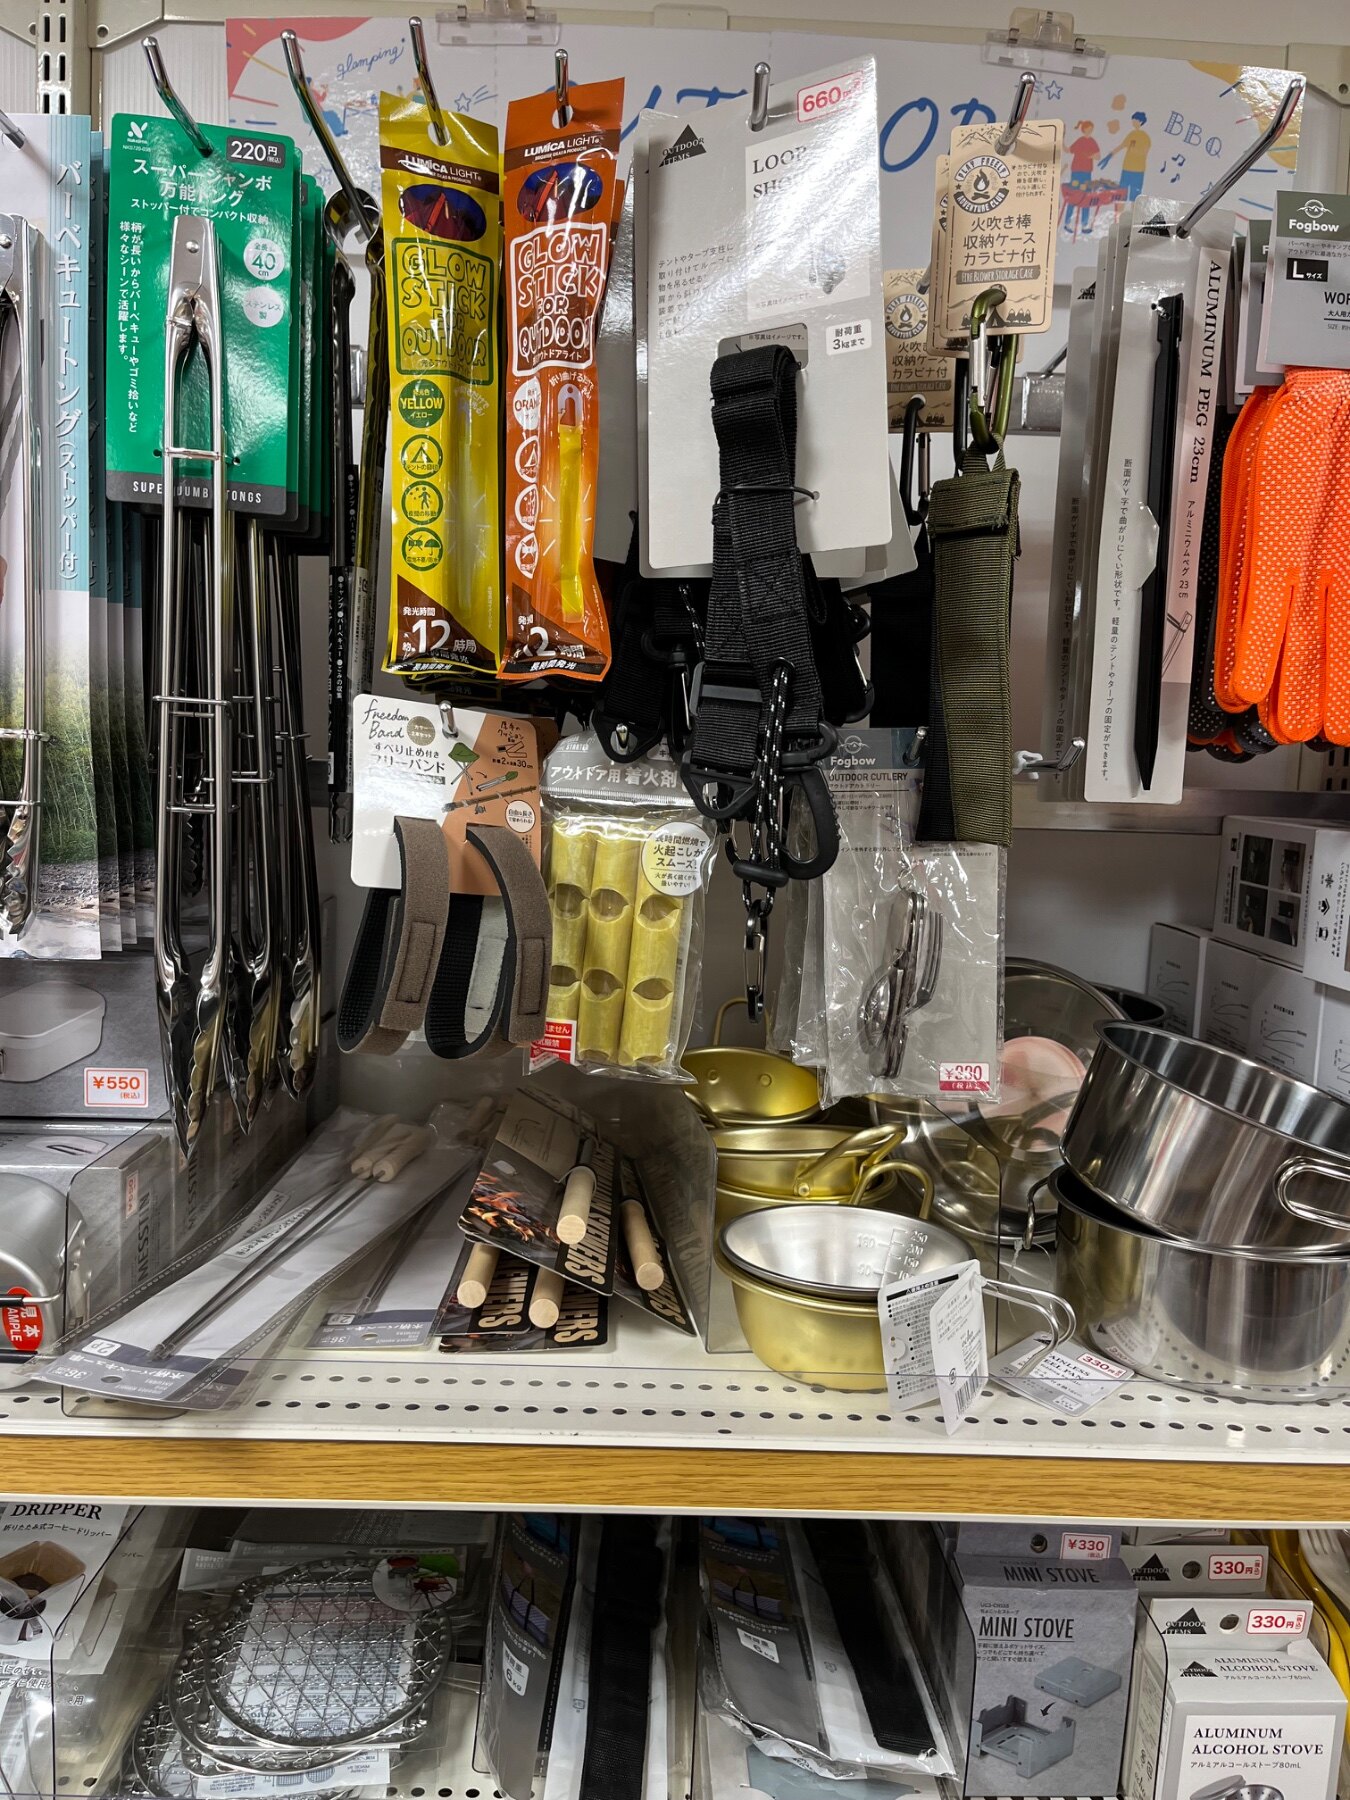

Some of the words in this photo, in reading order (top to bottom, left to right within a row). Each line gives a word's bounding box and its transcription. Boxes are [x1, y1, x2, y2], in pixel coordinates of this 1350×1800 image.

[337, 38, 406, 80] glamping
[1164, 110, 1222, 159] BBQ
[230, 140, 279, 162] 220円
[662, 136, 705, 156] OUTDOOR
[132, 158, 273, 192] スーパージャンボ
[957, 159, 975, 181] PLAY
[160, 180, 244, 207] 万能トング
[130, 198, 270, 226] ストッパー付でコンパクト収納
[971, 213, 1032, 232] 火吹き棒
[1288, 218, 1340, 234] Fogbow
[963, 231, 1036, 250] 収納ケース
[251, 253, 276, 270] 40
[518, 232, 600, 275] GLOW
[963, 248, 1036, 267] カラビナ付
[402, 244, 486, 291] GLOW
[961, 271, 974, 283] FIRE
[973, 269, 995, 282] BLOWER
[995, 268, 1019, 281] STORAGE
[1019, 267, 1034, 280] CASE
[518, 263, 599, 308] STICK
[402, 277, 485, 321] STICK
[536, 295, 569, 316] FOR
[1201, 260, 1222, 378] ALUMINUM
[834, 324, 863, 338] 耐荷重
[402, 326, 486, 367] OUTDOOR
[832, 336, 865, 351] 3kgまで
[892, 355, 948, 367] 収納ケース
[892, 367, 948, 379] カラビナ付
[400, 397, 443, 410] YELLOW
[1195, 386, 1212, 427] PEG
[410, 411, 433, 419] イエロー
[1190, 437, 1206, 484] 23cm
[132, 480, 163, 495] SUPE
[1181, 500, 1195, 577] アルミニウムペグ
[1178, 580, 1189, 590] 23
[1178, 591, 1189, 599] cm
[403, 607, 436, 617] 発光時間
[368, 720, 405, 740] Band
[830, 755, 876, 768] Fogbow
[625, 768, 678, 789] 着火剤
[829, 772, 869, 782] OUTDOOR
[870, 772, 908, 781] CUTLERY
[653, 845, 704, 857] 火起こしが
[92, 1076, 141, 1090] ¥550
[120, 1092, 141, 1100] (税込)
[138, 1191, 150, 1282] MESSTIN
[7, 1307, 23, 1342] AMPLE
[20, 1306, 40, 1338] 見本
[10, 1503, 103, 1520] DRIPPER
[1067, 1538, 1105, 1552] ¥330
[1003, 1565, 1043, 1582] MINI
[1046, 1567, 1100, 1583] STOVE
[1212, 1561, 1253, 1575] 330円
[979, 1616, 1018, 1638] MINI
[1023, 1617, 1075, 1639] STOVE
[1165, 1619, 1206, 1628] OUTDOOR
[1251, 1615, 1294, 1630] 330円
[1214, 1657, 1280, 1665] ALUMINUM
[1193, 1727, 1283, 1739] ALUMINUM
[1191, 1744, 1268, 1755] ALCOHOL
[1272, 1744, 1324, 1755] STOVE
